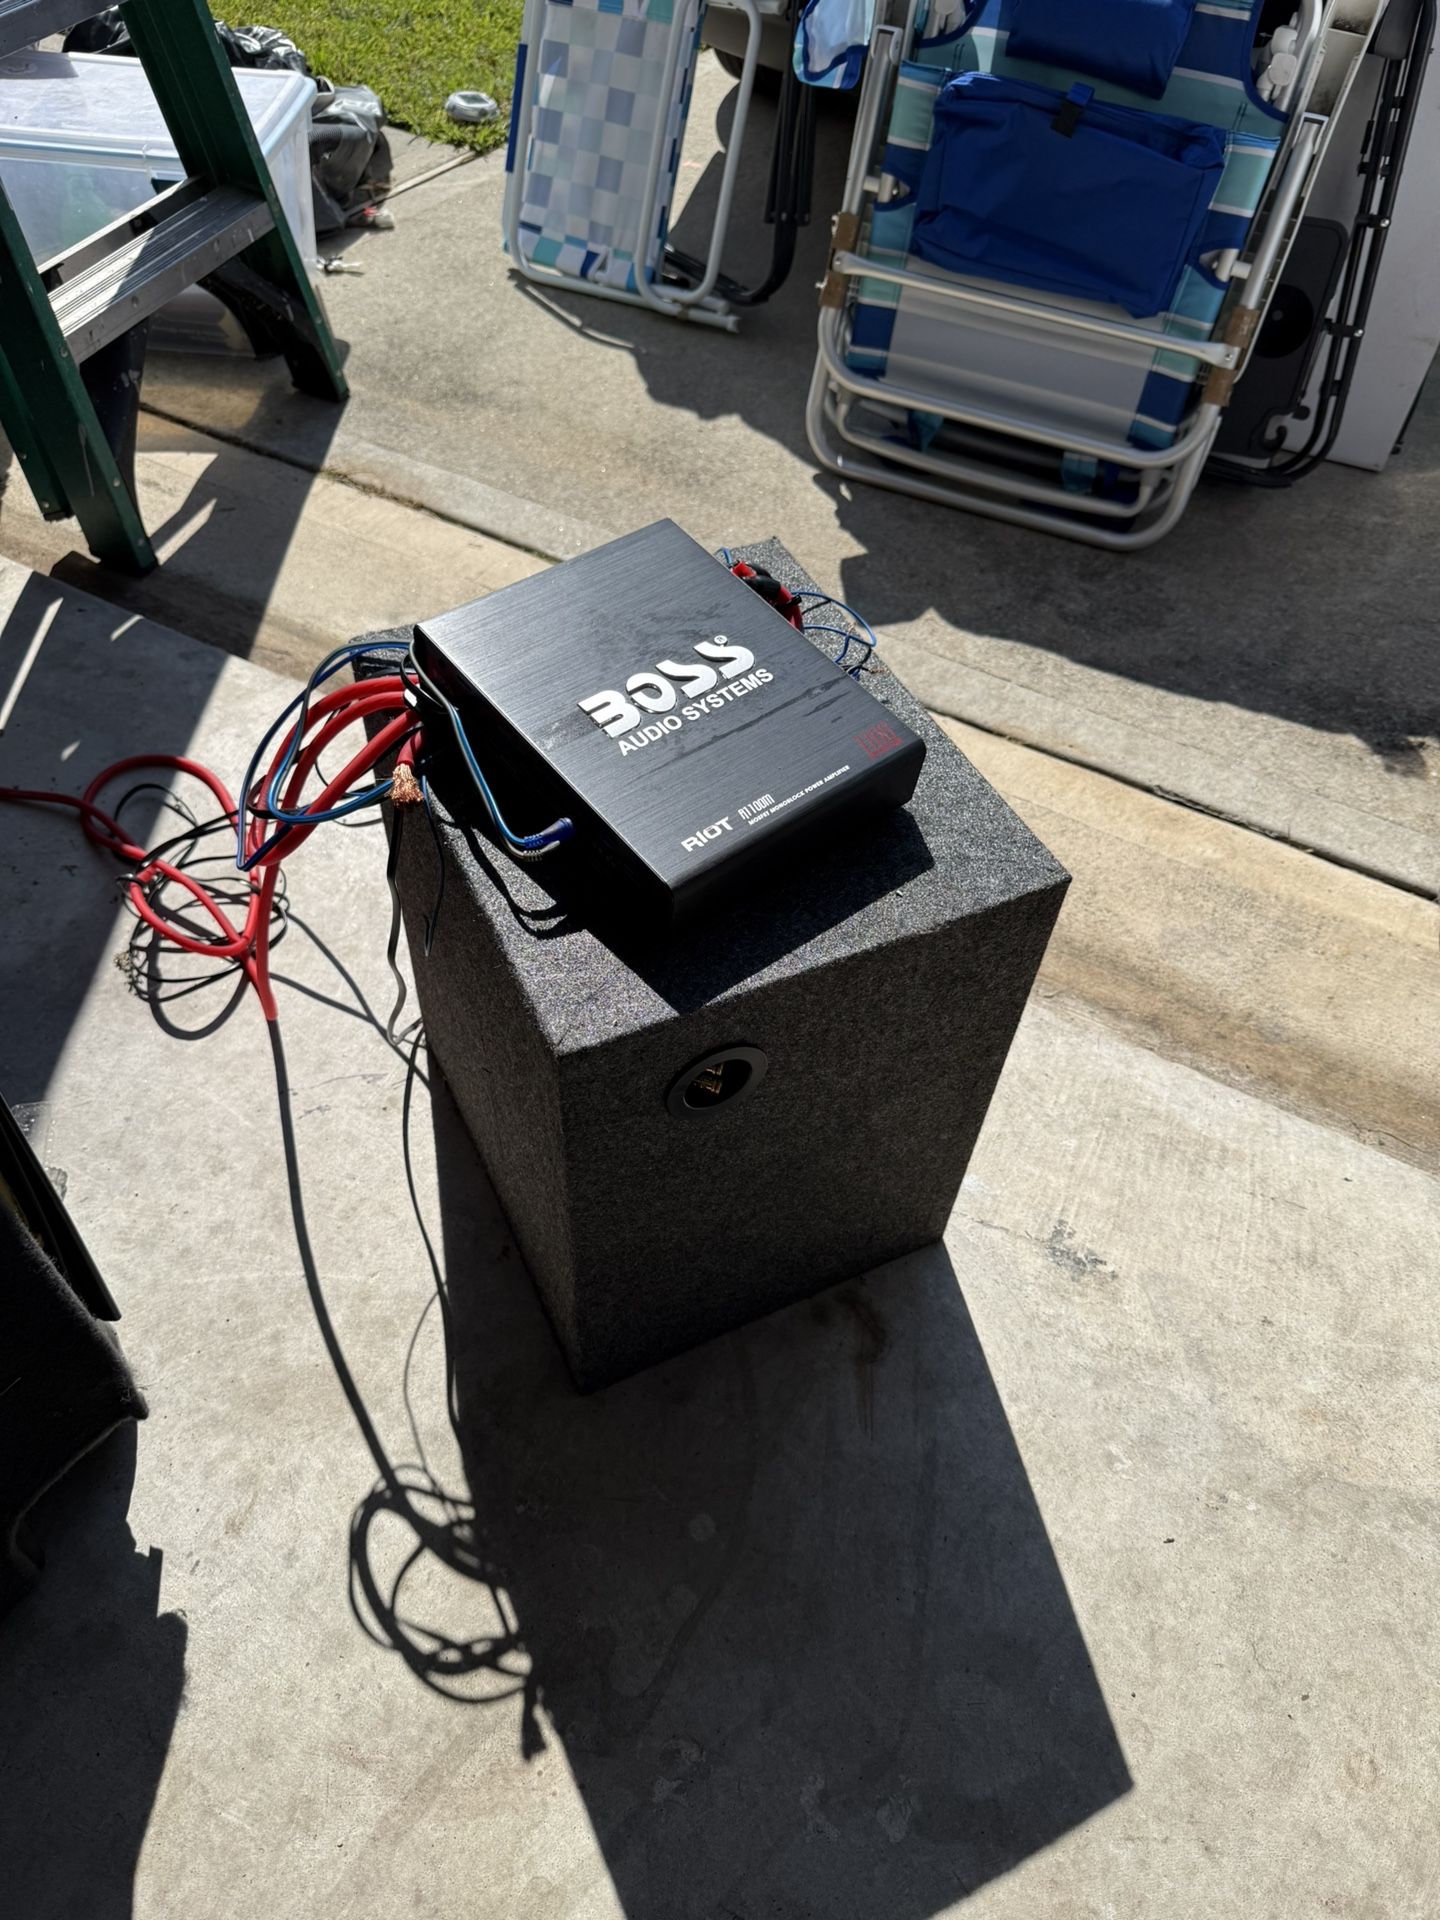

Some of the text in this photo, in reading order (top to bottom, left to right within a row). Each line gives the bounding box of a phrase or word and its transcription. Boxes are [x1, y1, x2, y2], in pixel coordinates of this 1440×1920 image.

[577, 637, 756, 738] BOSS
[618, 668, 774, 756] AUDIO SYSTEMS
[748, 764, 850, 826] MOSFET MONOBLOCK POWER AMPLIFIER
[680, 816, 733, 852] RIOT
